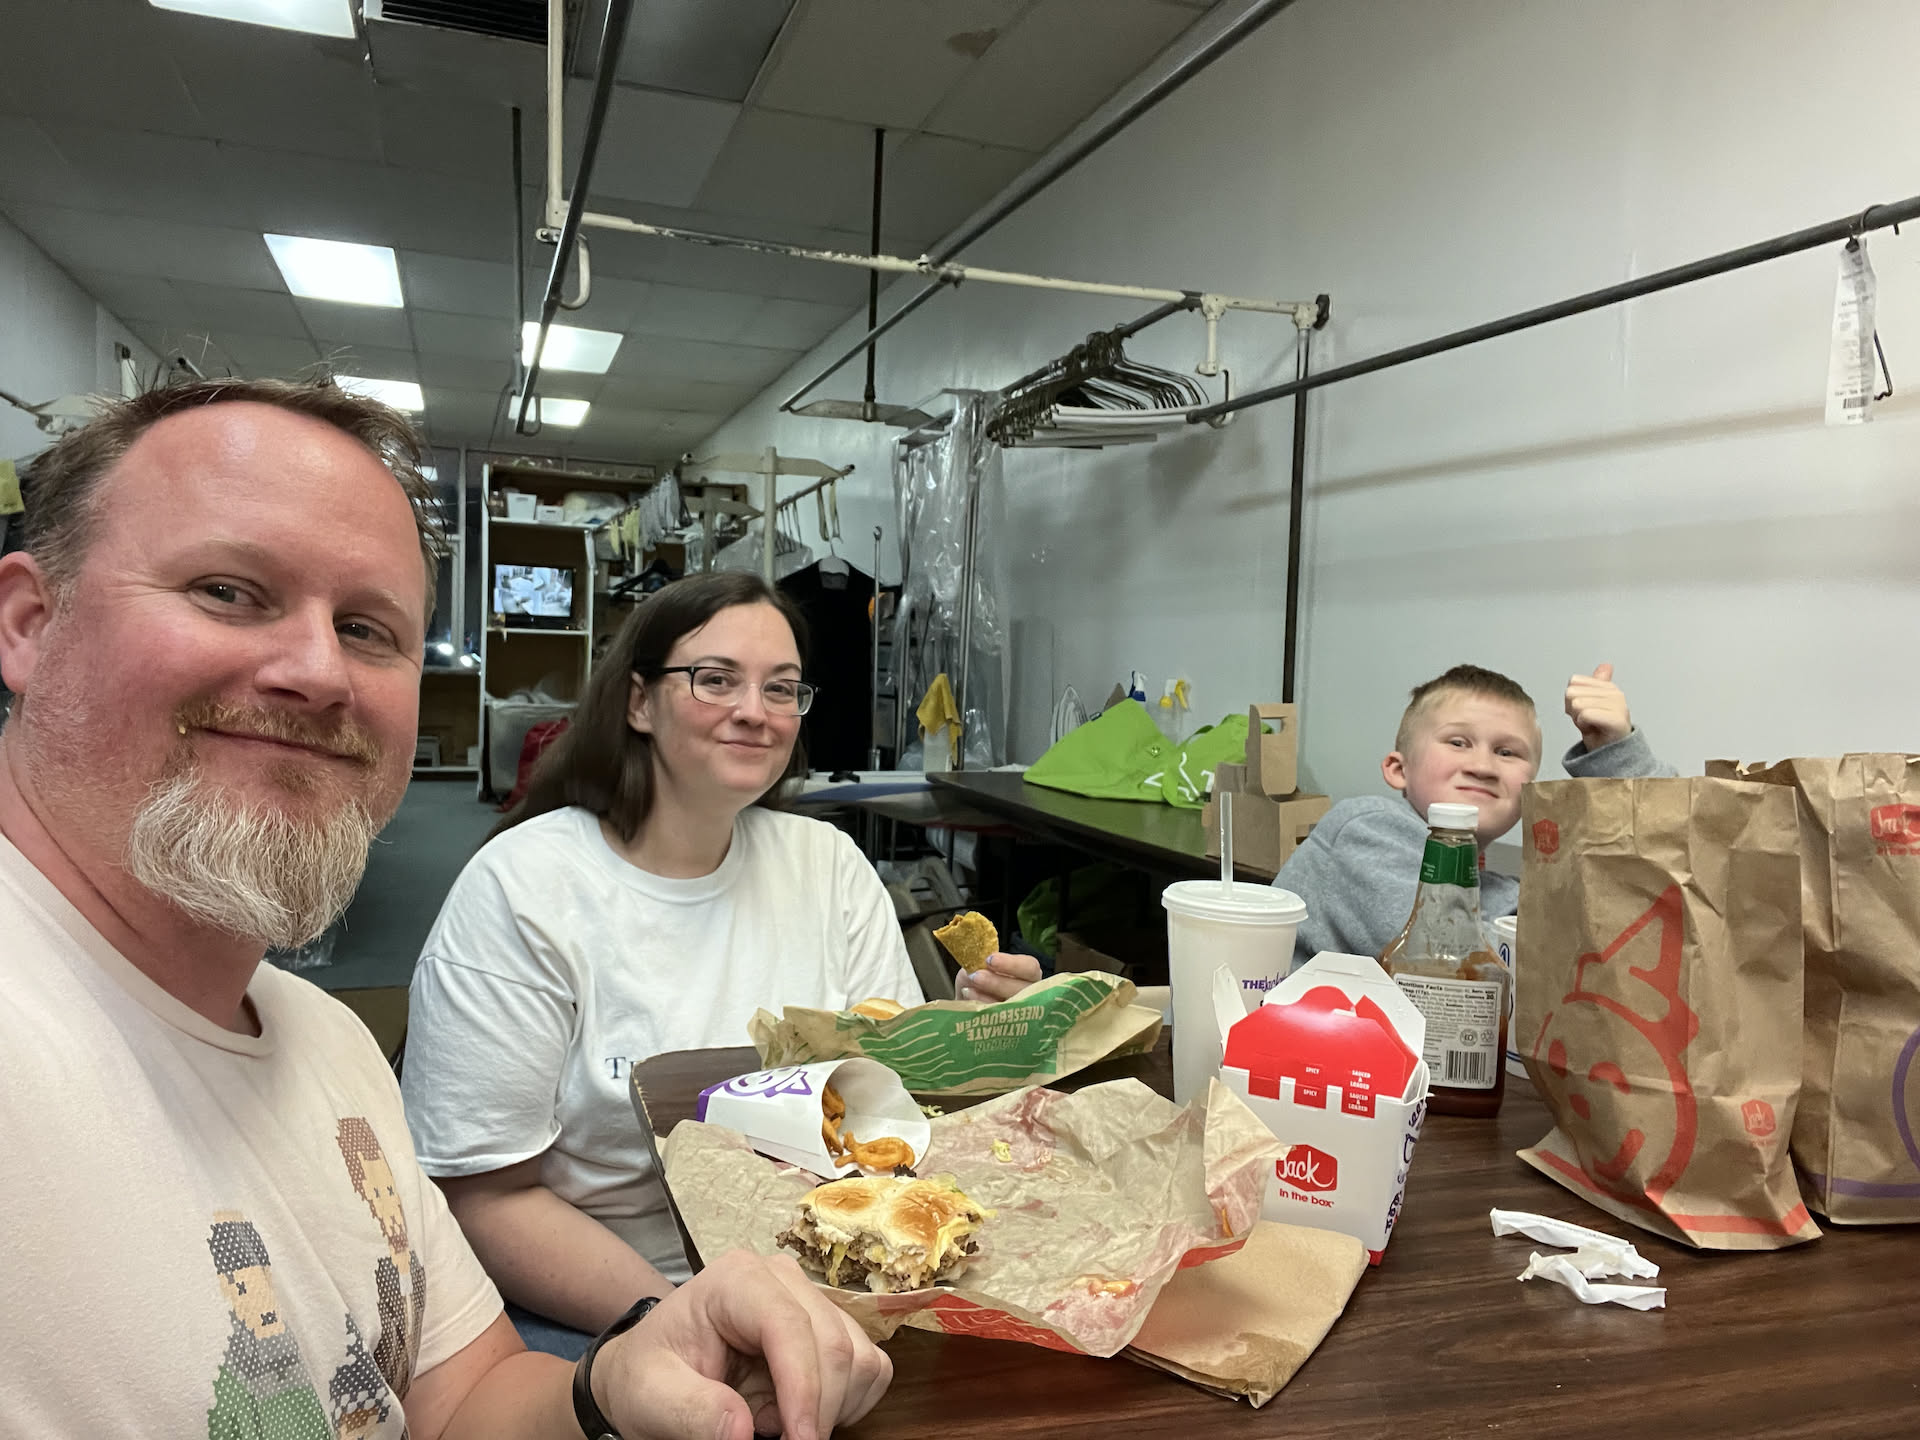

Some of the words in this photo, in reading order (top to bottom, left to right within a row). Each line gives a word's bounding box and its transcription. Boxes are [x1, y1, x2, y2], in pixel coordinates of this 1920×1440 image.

[1242, 979, 1265, 990] THE
[955, 1005, 1044, 1034] CHEESEBURGER
[967, 1022, 1028, 1041] ULTIMATE
[1305, 1066, 1320, 1075] SPICY
[1351, 1069, 1371, 1079] SAUCED
[1350, 1080, 1370, 1090] LOADED
[1303, 1088, 1317, 1097] SPICY
[1349, 1092, 1369, 1101] SAUCED
[1348, 1103, 1368, 1112] LOADED
[1277, 1150, 1335, 1188] Jack
[1291, 1191, 1309, 1202] the
[1311, 1195, 1333, 1208] box
